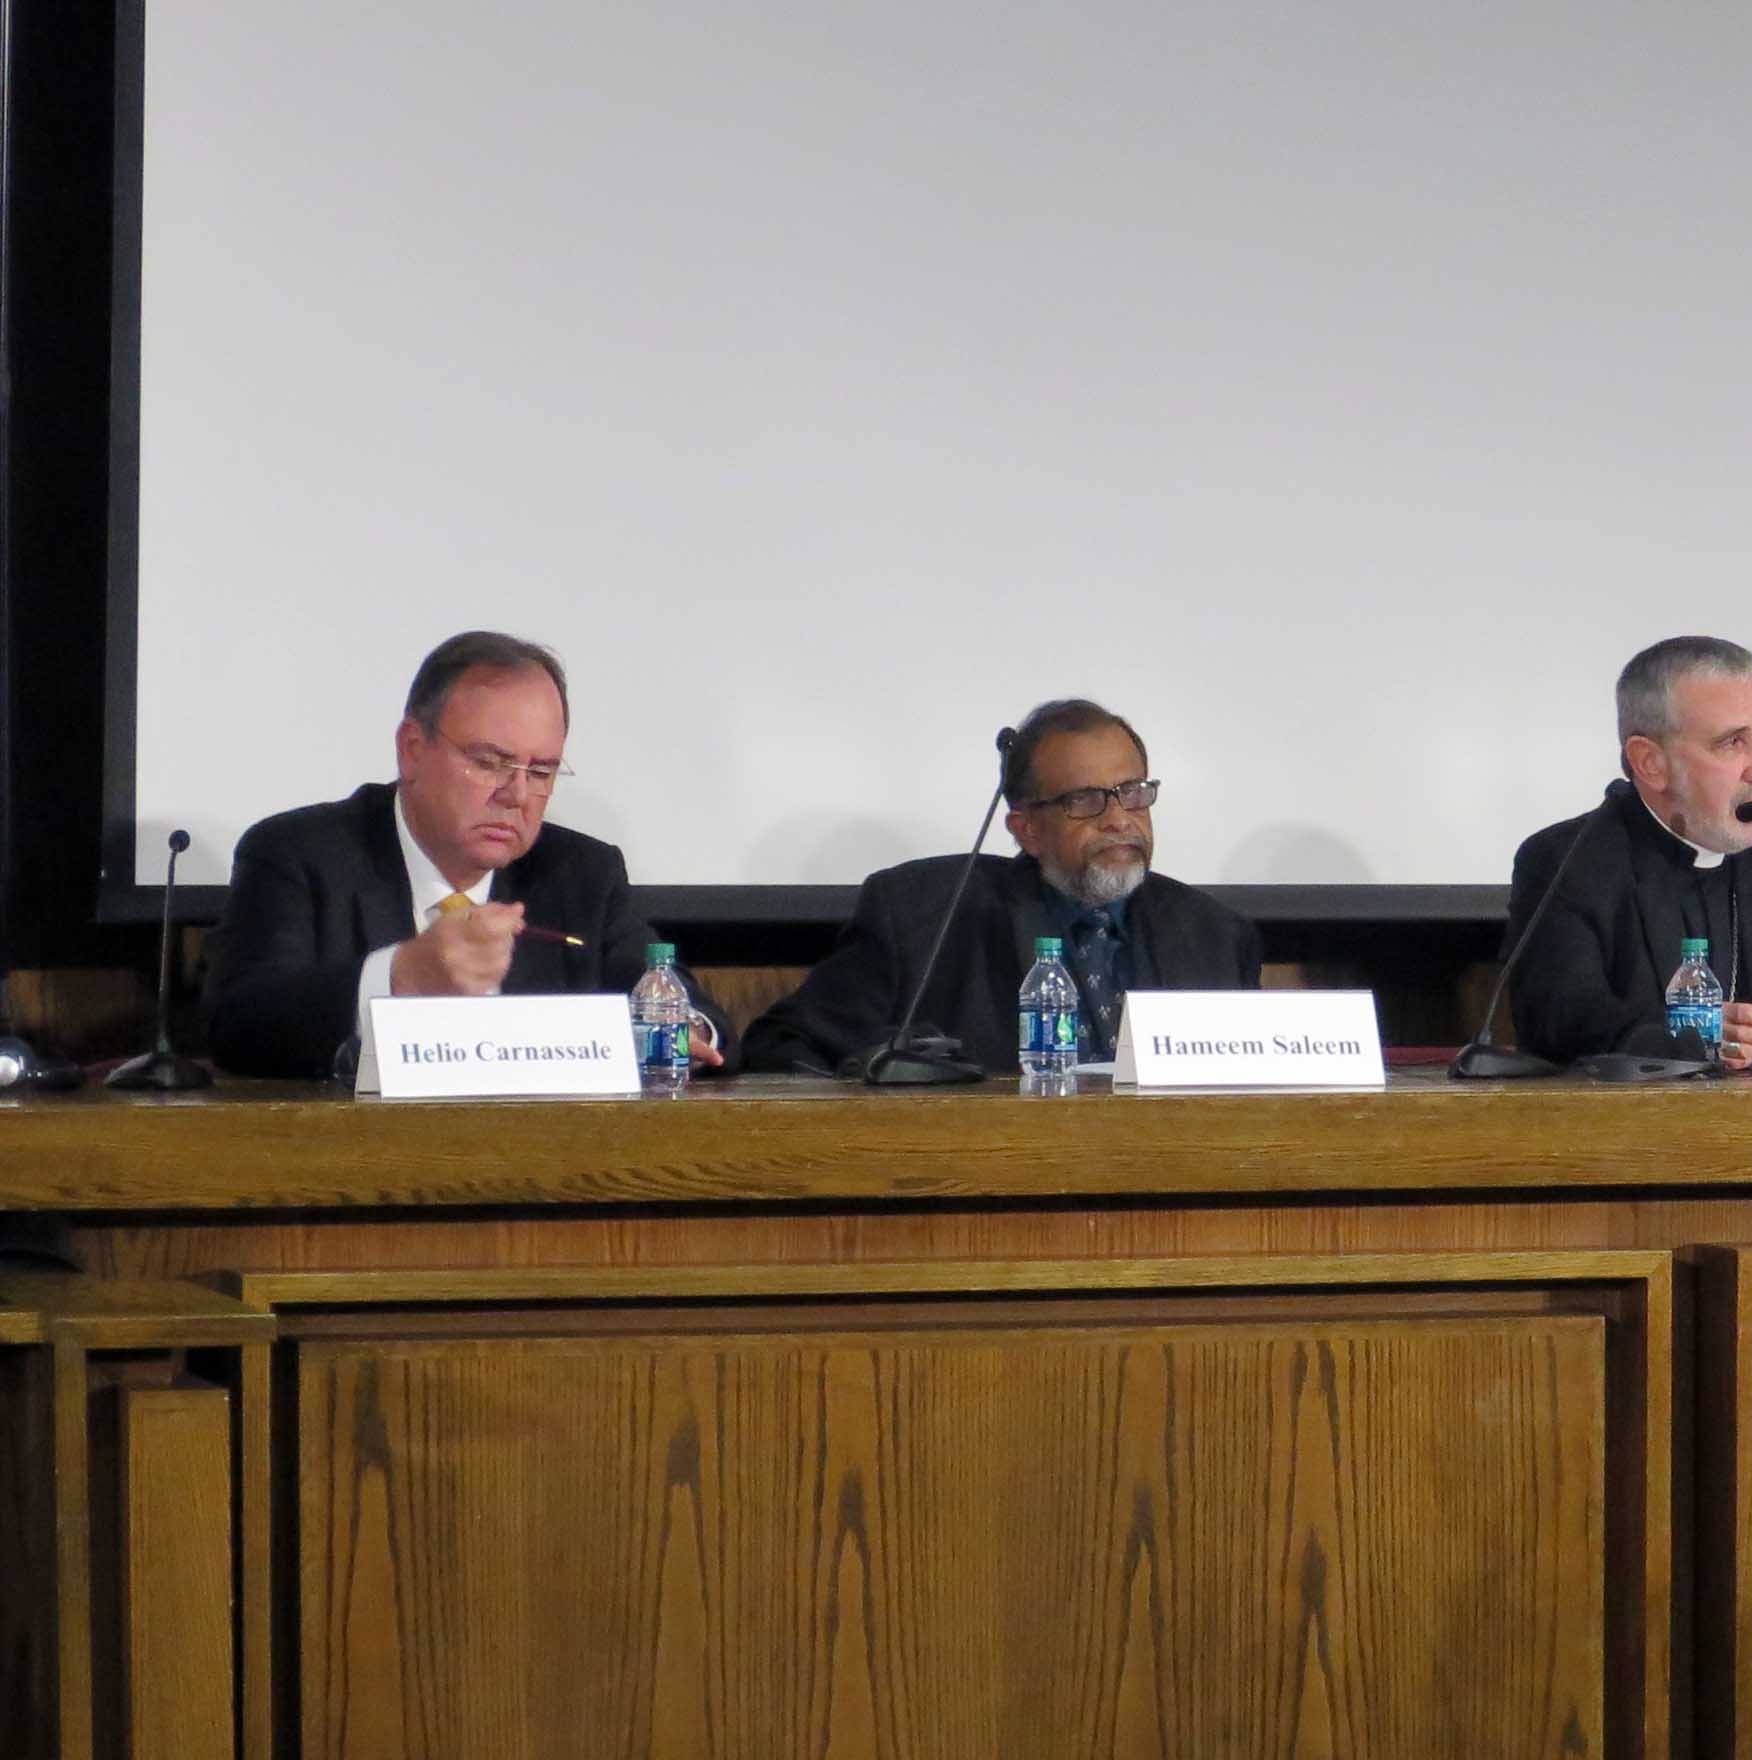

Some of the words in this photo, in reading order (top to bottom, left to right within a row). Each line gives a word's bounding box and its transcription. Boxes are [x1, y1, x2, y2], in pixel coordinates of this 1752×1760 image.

[399, 1041, 468, 1065] Helio
[474, 1039, 612, 1062] Carnassale
[1151, 1035, 1265, 1056] Hameem
[1272, 1034, 1361, 1056] Saleem
